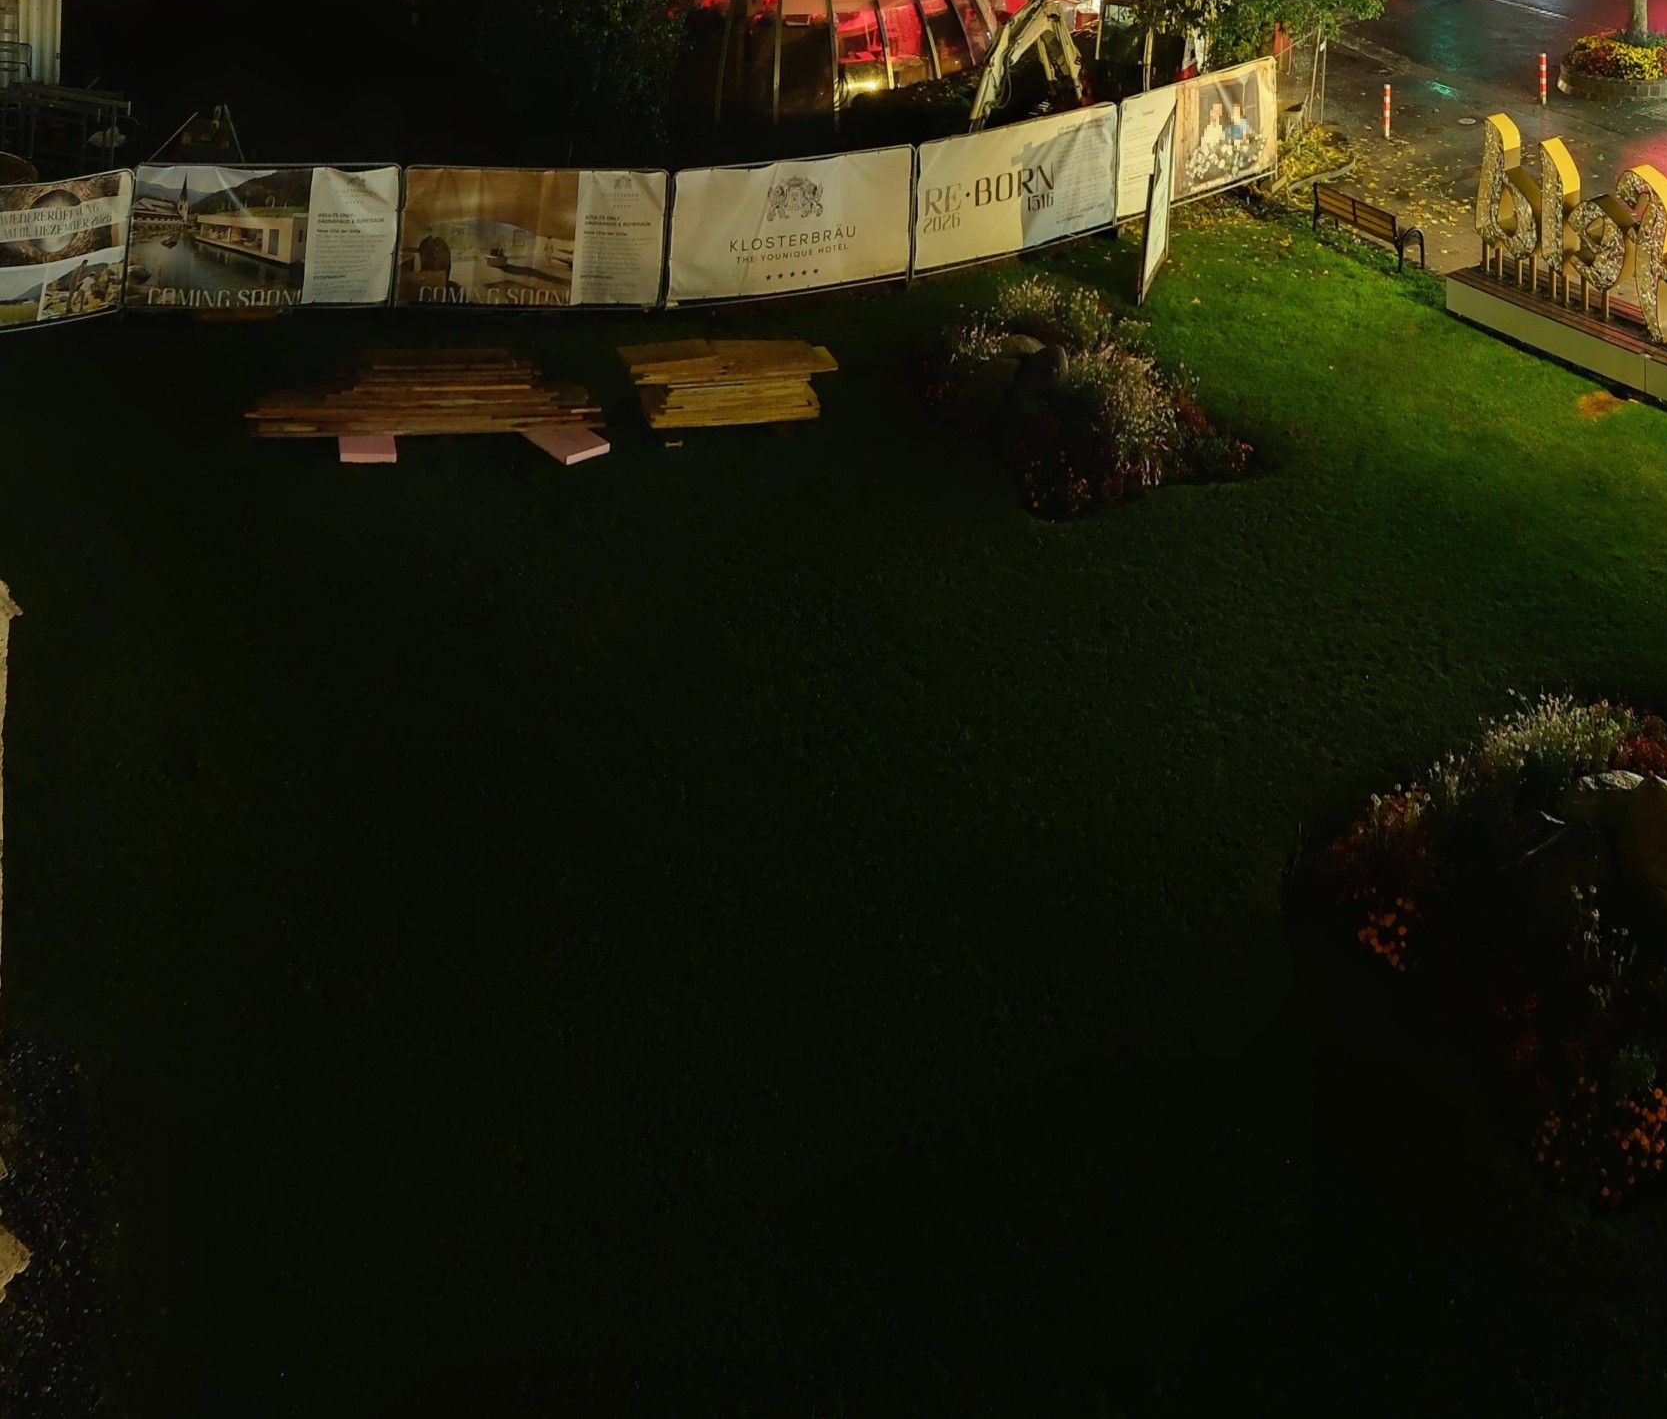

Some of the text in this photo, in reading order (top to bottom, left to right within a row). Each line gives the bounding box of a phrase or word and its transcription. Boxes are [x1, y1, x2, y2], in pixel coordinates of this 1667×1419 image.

[35, 219, 89, 237] DEZEMBER
[923, 212, 961, 235] 2026
[729, 223, 857, 253] KLOSTERBRÄU
[736, 243, 849, 264] THE YOUNIQUE HOTEL
